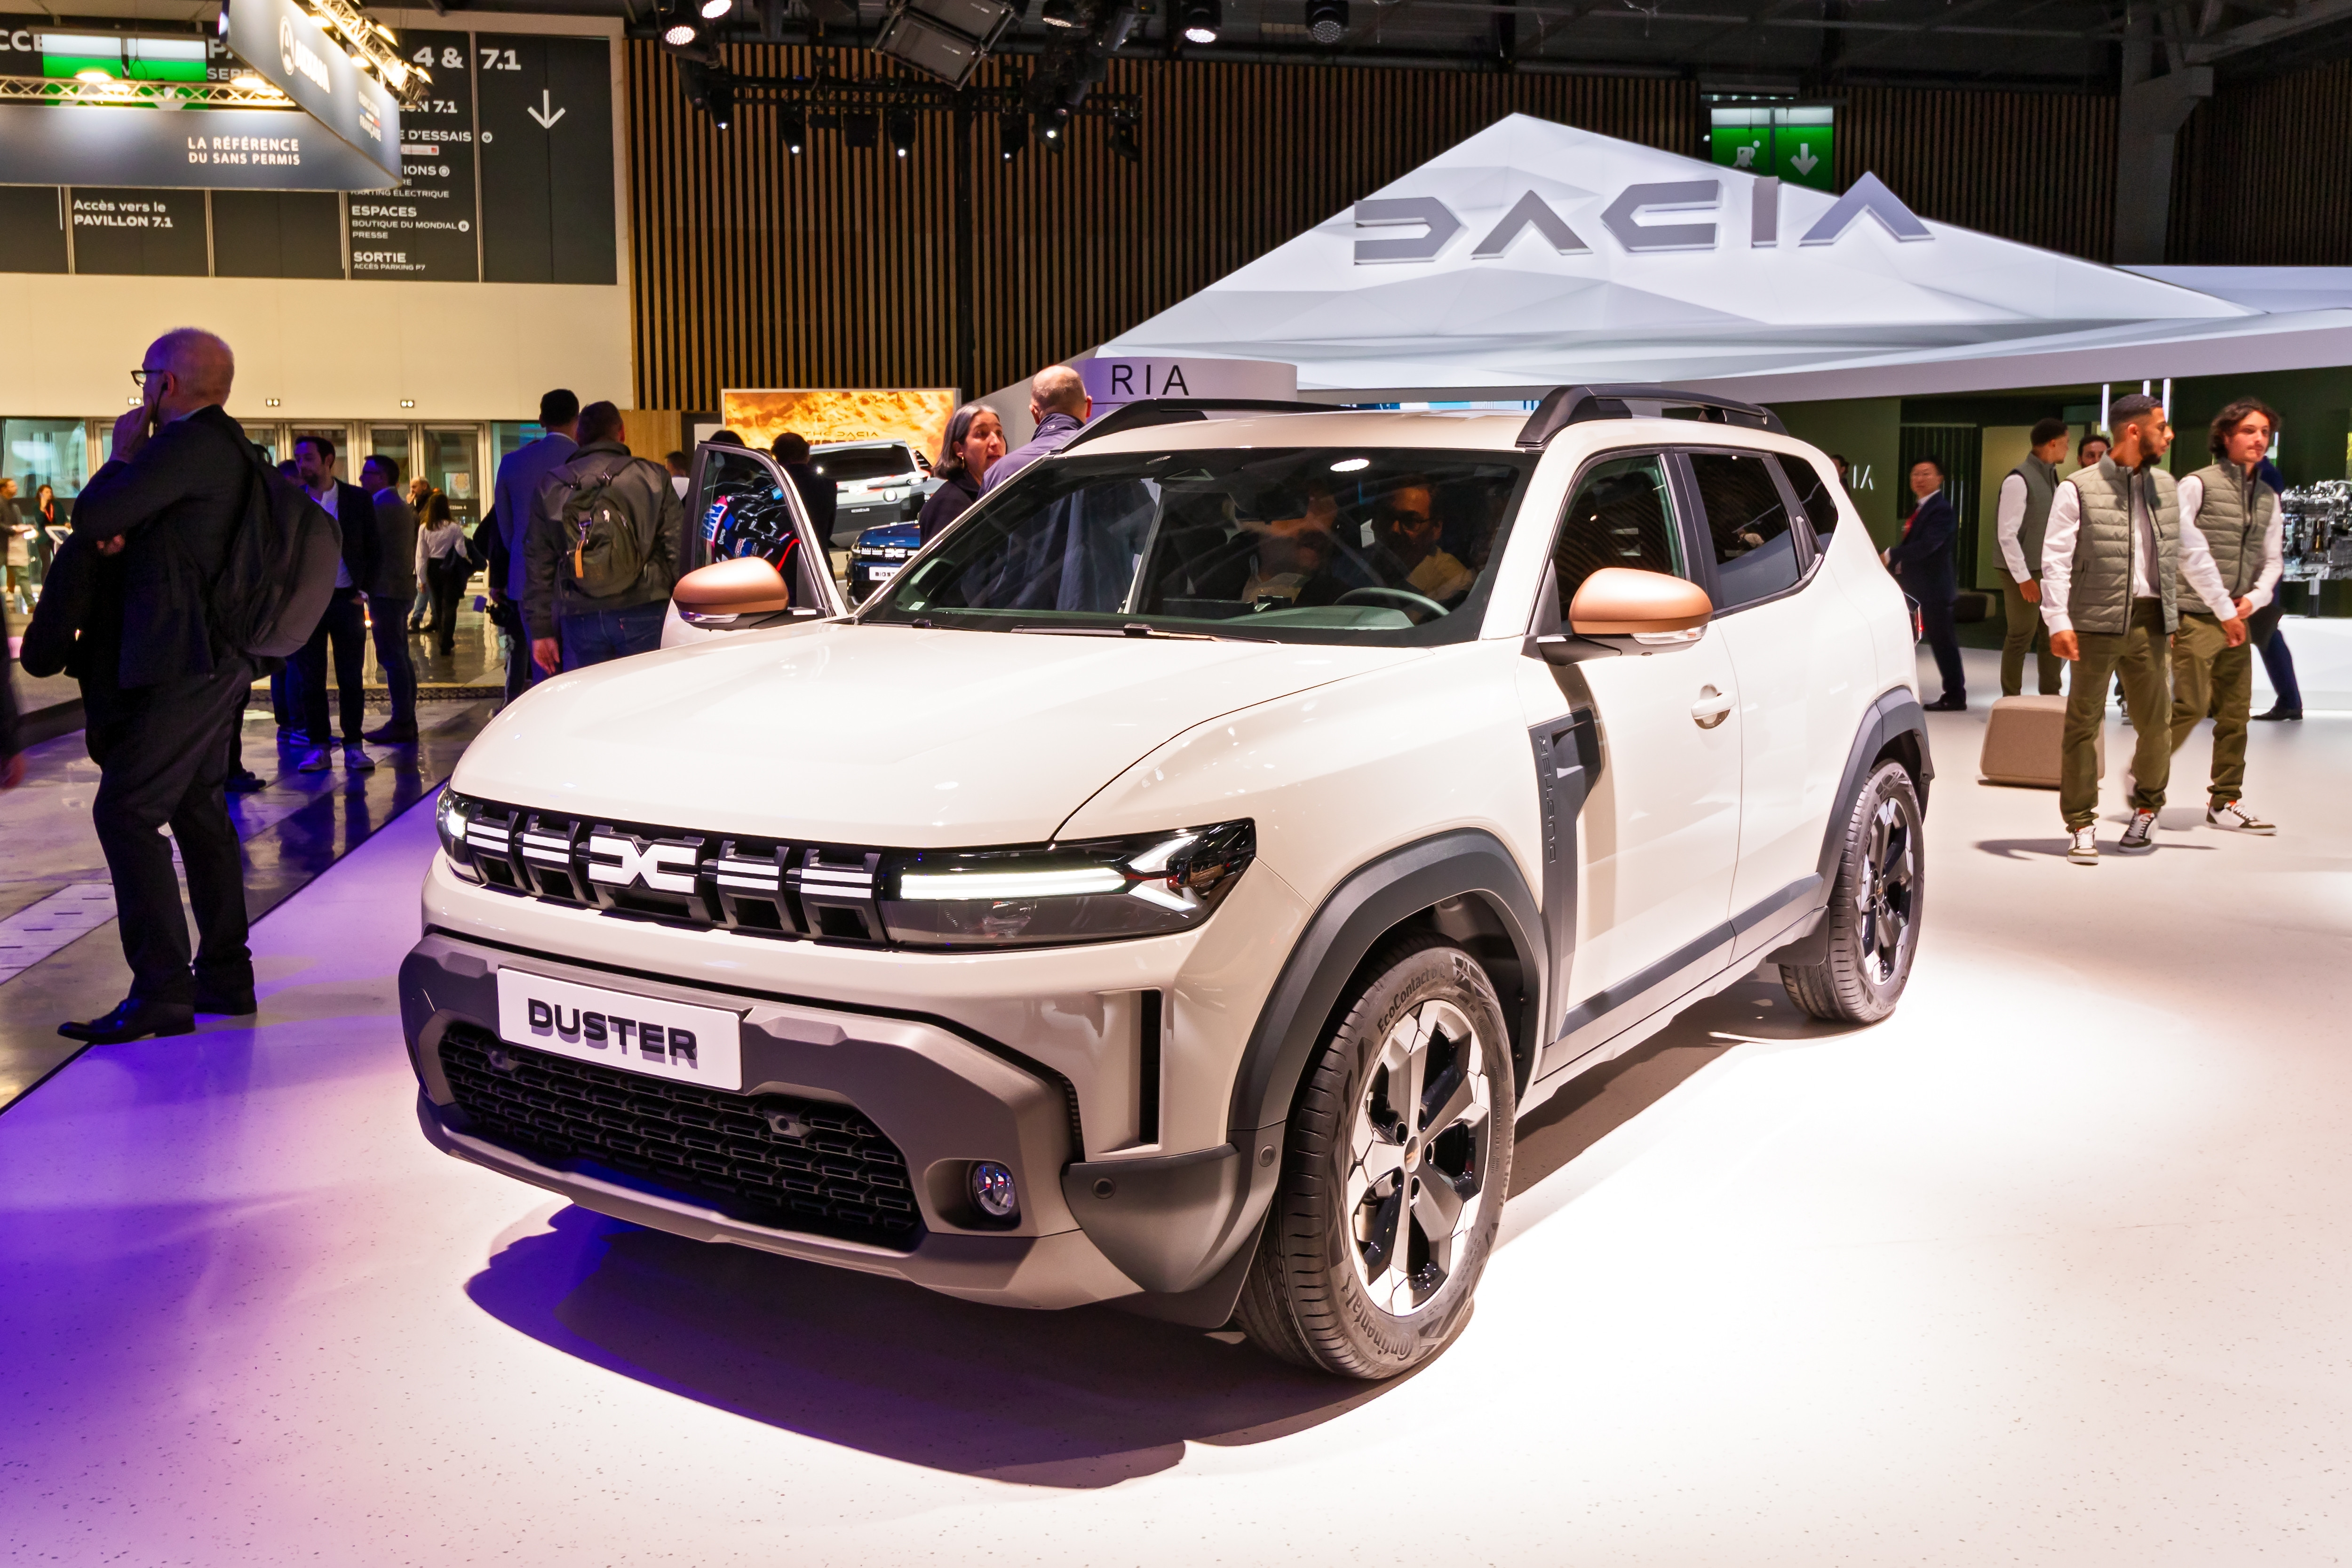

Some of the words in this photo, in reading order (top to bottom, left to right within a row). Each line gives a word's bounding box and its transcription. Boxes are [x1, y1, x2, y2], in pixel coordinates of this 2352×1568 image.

[413, 47, 435, 67] 4
[441, 48, 464, 69] &
[480, 49, 521, 70] 7.1
[433, 100, 458, 113] 7.1
[408, 129, 472, 142] D'ESSAIS
[188, 136, 207, 150] LA
[213, 135, 299, 151] RÉFÉRENCE
[189, 151, 207, 164] DU
[213, 152, 247, 164] SANS
[252, 153, 300, 166] PERMIS
[73, 199, 115, 211] Accès
[119, 202, 150, 212] vers
[154, 201, 166, 213] le
[352, 205, 417, 217] ESPACES
[74, 214, 148, 227] PAVILLON
[152, 216, 173, 228] 7.1
[352, 220, 398, 229] BOUTIQUE
[416, 221, 457, 230] MONDIAL
[1354, 171, 1935, 266] DACIA
[354, 251, 406, 263] SORTIE
[1376, 969, 1430, 1035] EcoContact
[528, 998, 697, 1061] DUSTER
[1345, 1288, 1413, 1361] Continental
